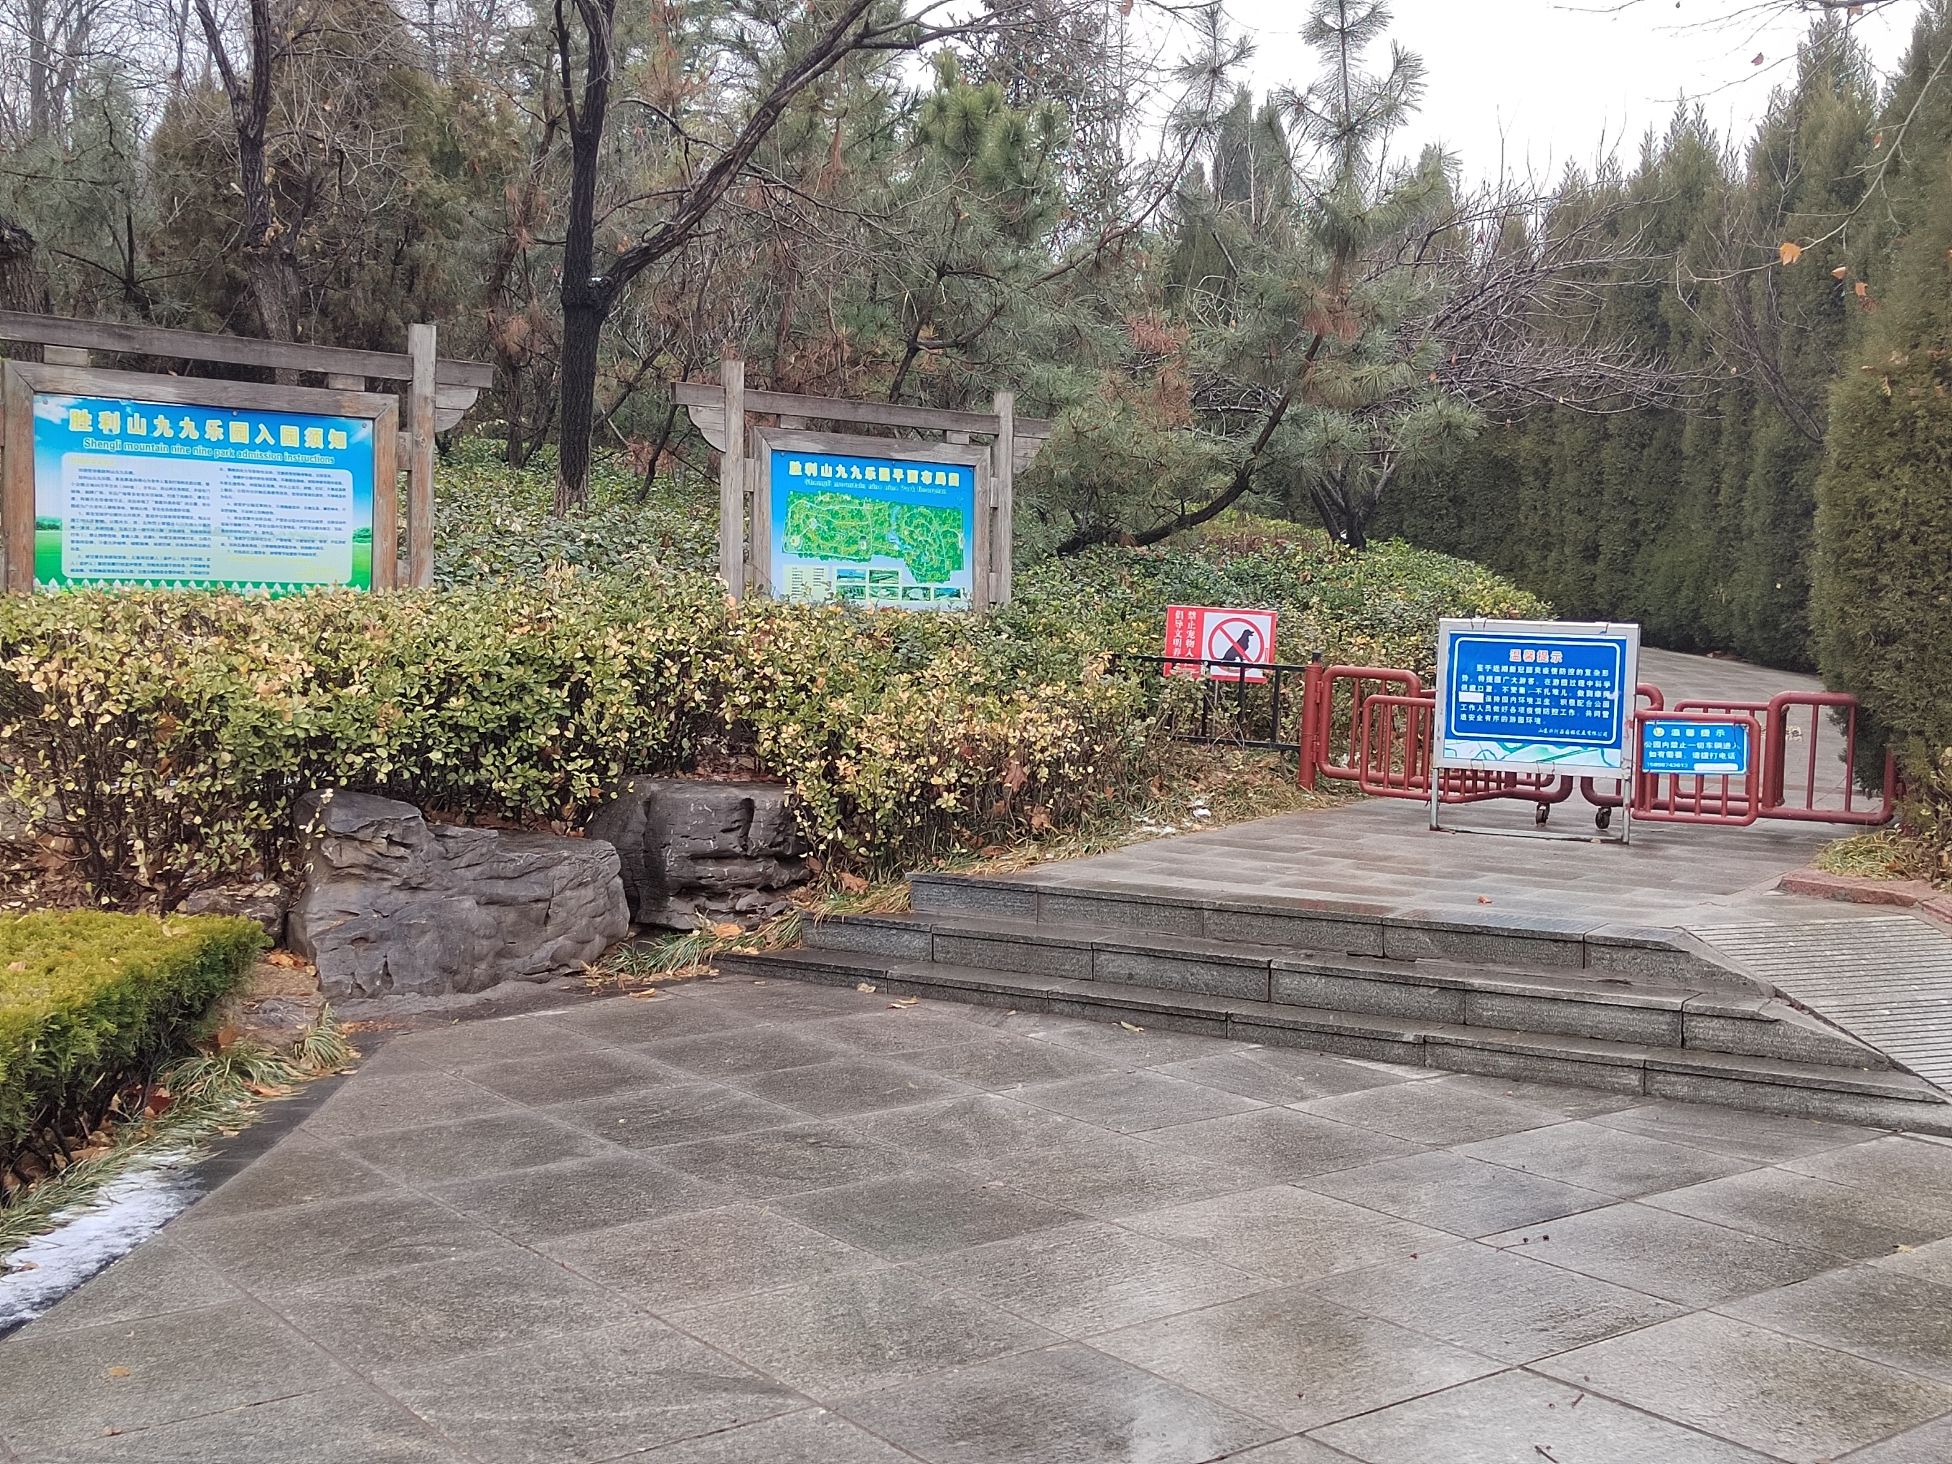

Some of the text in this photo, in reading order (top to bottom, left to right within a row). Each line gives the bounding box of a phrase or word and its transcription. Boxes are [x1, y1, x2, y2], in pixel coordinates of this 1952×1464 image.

[69, 408, 348, 450] 胜利山九九乐园入园须知
[83, 438, 121, 452] Shengli
[123, 442, 169, 454] mountain
[214, 447, 235, 459] park
[237, 449, 283, 462] admission
[284, 451, 335, 465] instructions
[1509, 648, 1563, 663] 温馨提示
